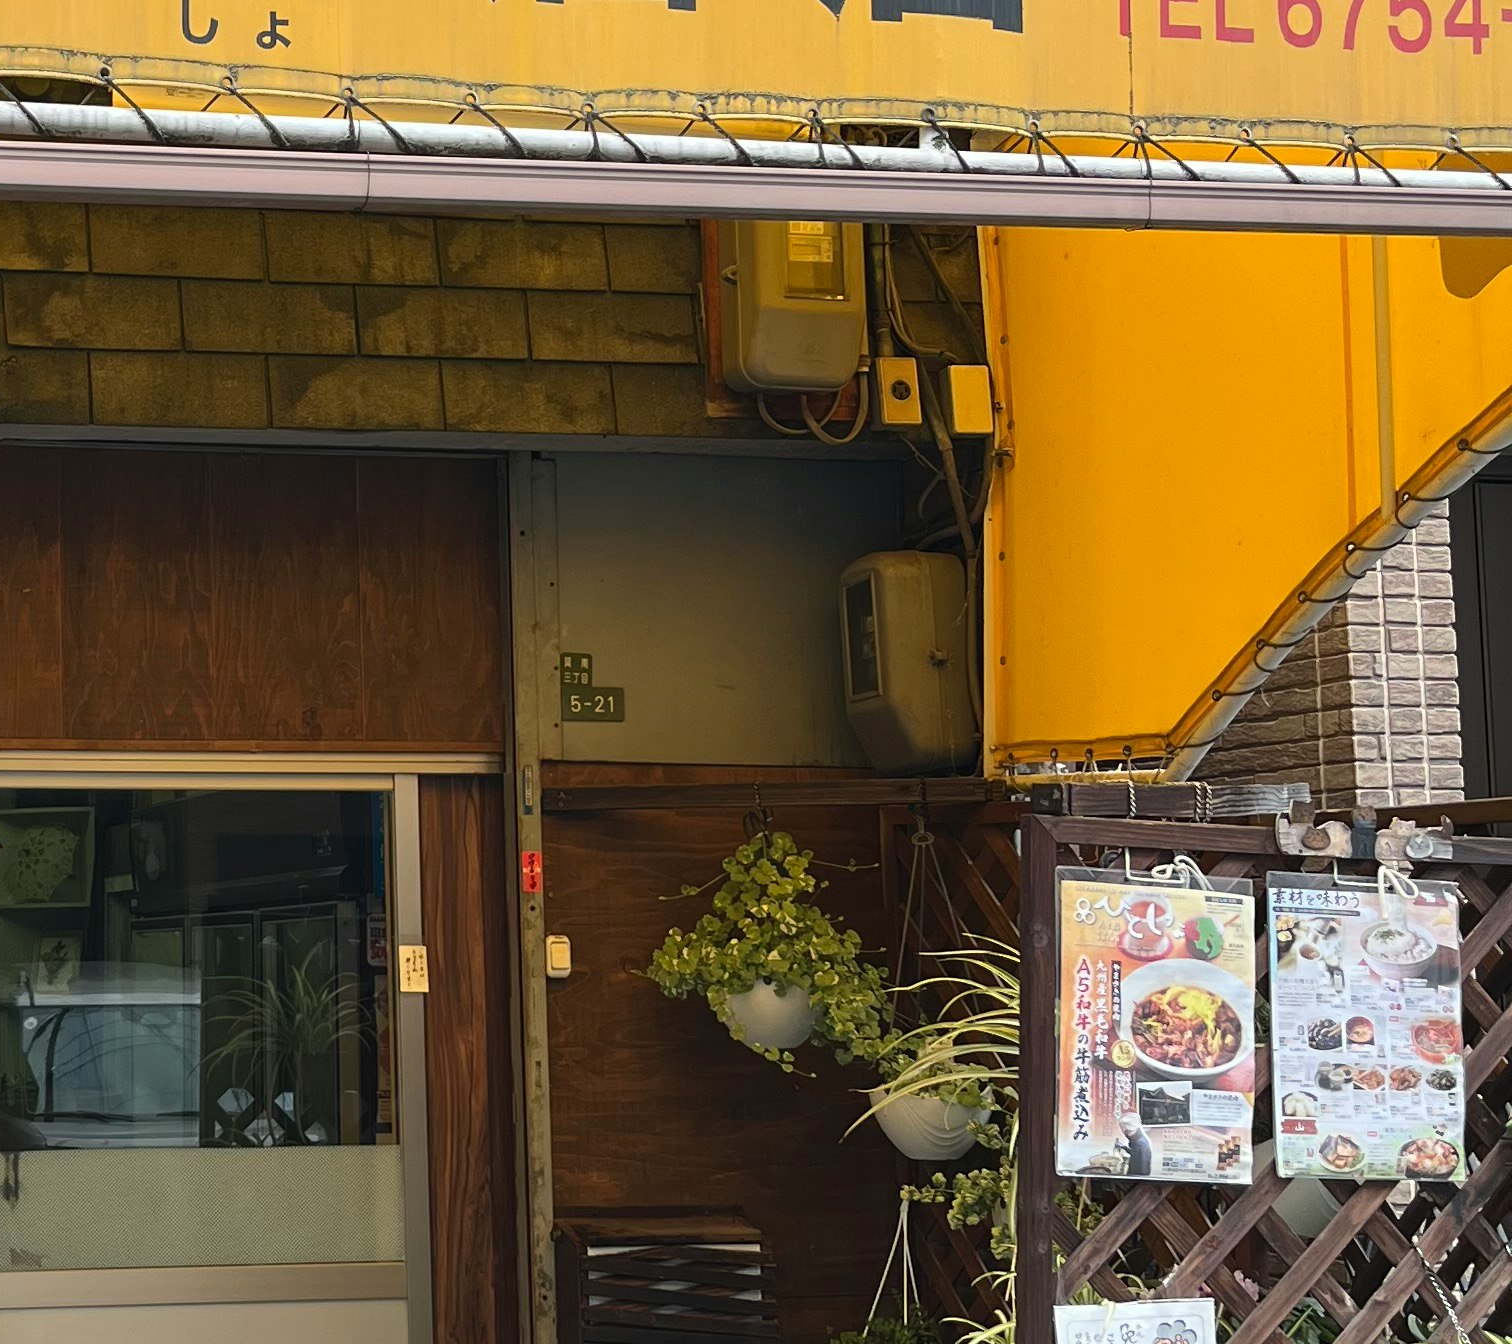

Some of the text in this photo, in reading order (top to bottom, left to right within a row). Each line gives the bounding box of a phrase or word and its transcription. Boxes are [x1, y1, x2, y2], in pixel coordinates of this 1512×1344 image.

[570, 695, 615, 713] 5-21
[1271, 888, 1361, 910] 素材を味わう
[1093, 959, 1110, 1061] 九州産黒毛和牛
[1072, 958, 1092, 1142] A5和牛の牛筋煮込み
